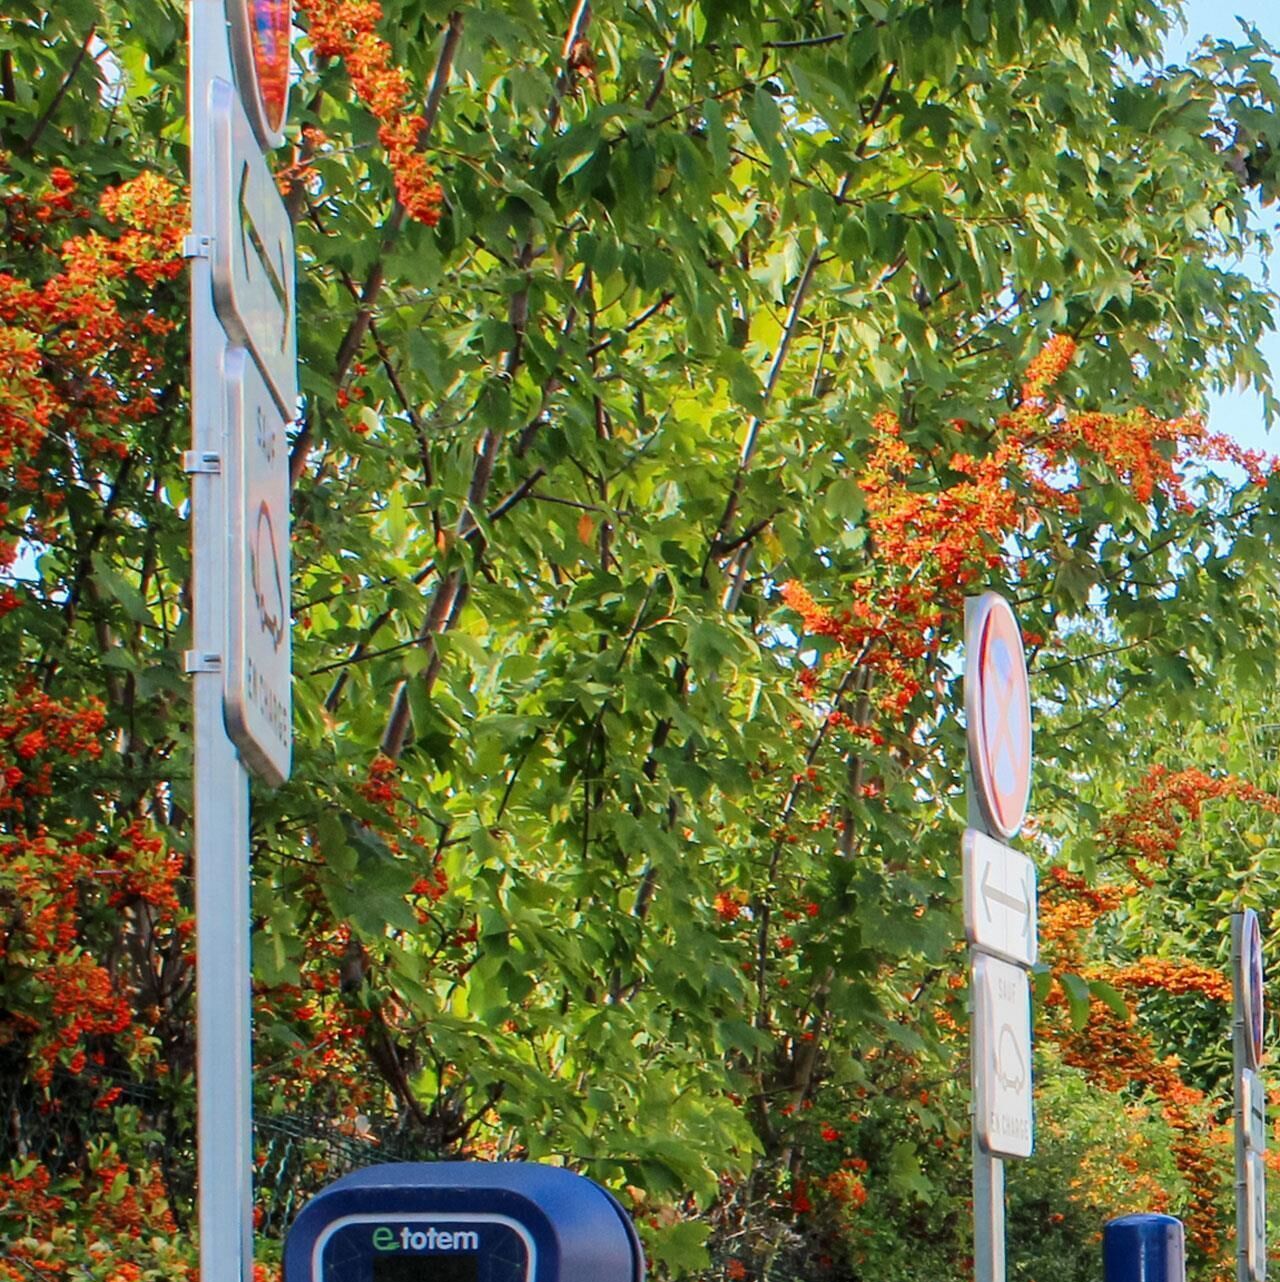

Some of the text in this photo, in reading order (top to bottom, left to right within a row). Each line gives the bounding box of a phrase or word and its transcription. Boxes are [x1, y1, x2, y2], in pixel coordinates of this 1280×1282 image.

[248, 656, 288, 747] EN CHARGE
[1002, 1113, 1029, 1141] CHARGE
